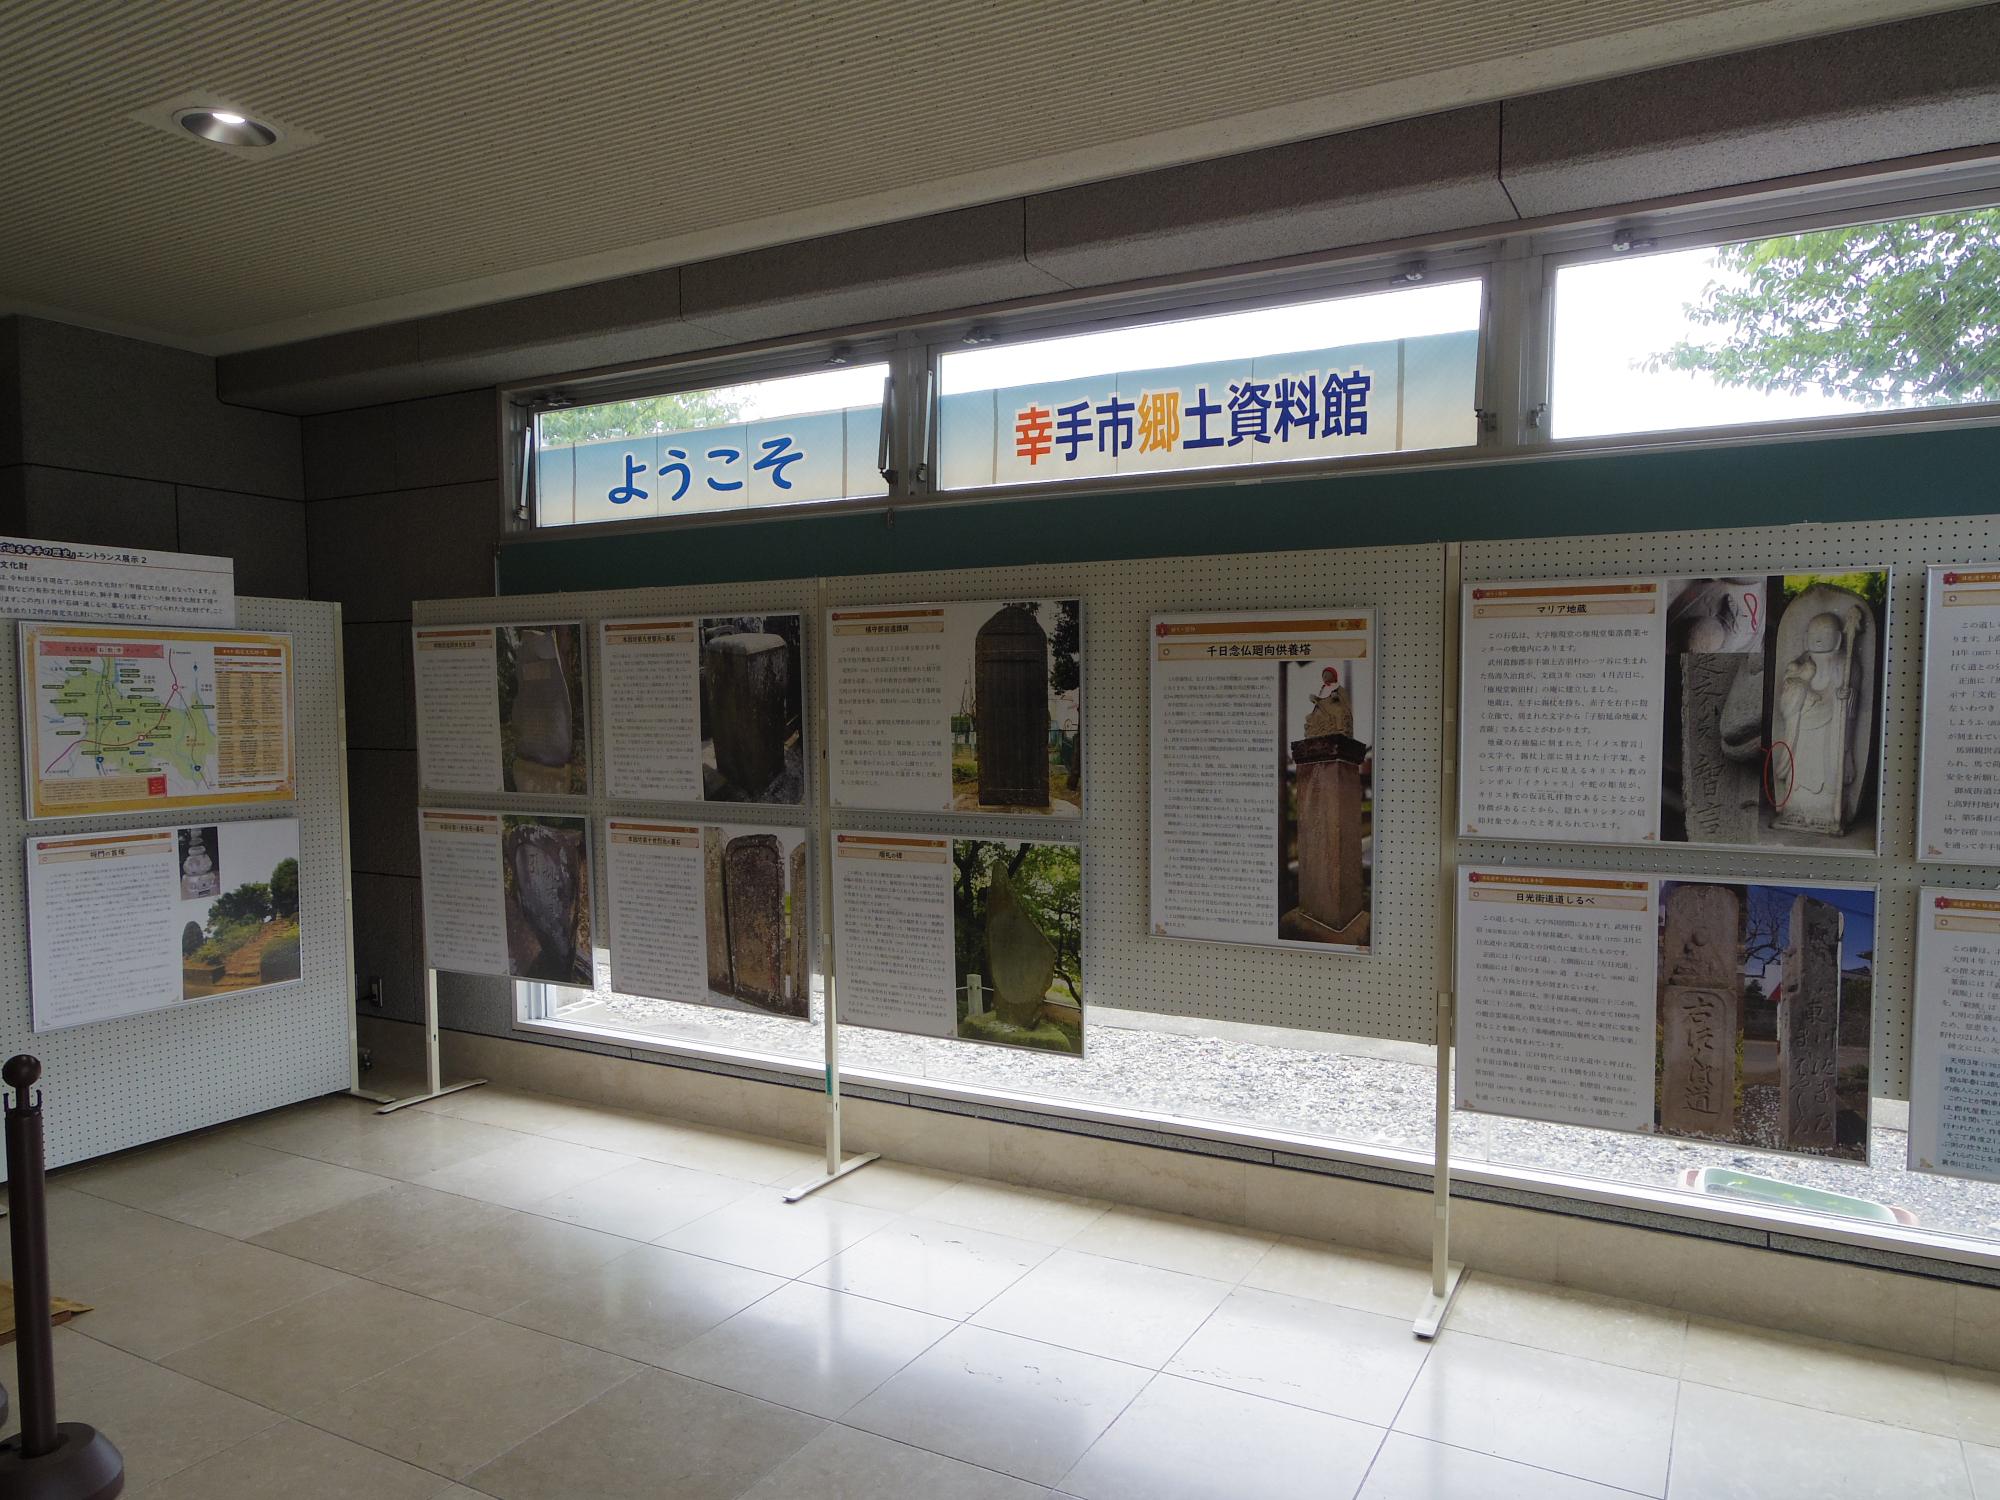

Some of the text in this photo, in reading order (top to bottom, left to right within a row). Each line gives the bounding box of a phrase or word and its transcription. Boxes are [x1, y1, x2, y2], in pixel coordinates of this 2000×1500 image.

[1014, 368, 1370, 466] 幸手市郷土資料館
[608, 433, 804, 504] ようこそ
[1536, 604, 1588, 614] マリア地蔵
[1960, 621, 2000, 629] この道し
[1206, 643, 1313, 657] 千日念仏廻向供養塔
[1515, 892, 1596, 905] 日光街道道しるべ
